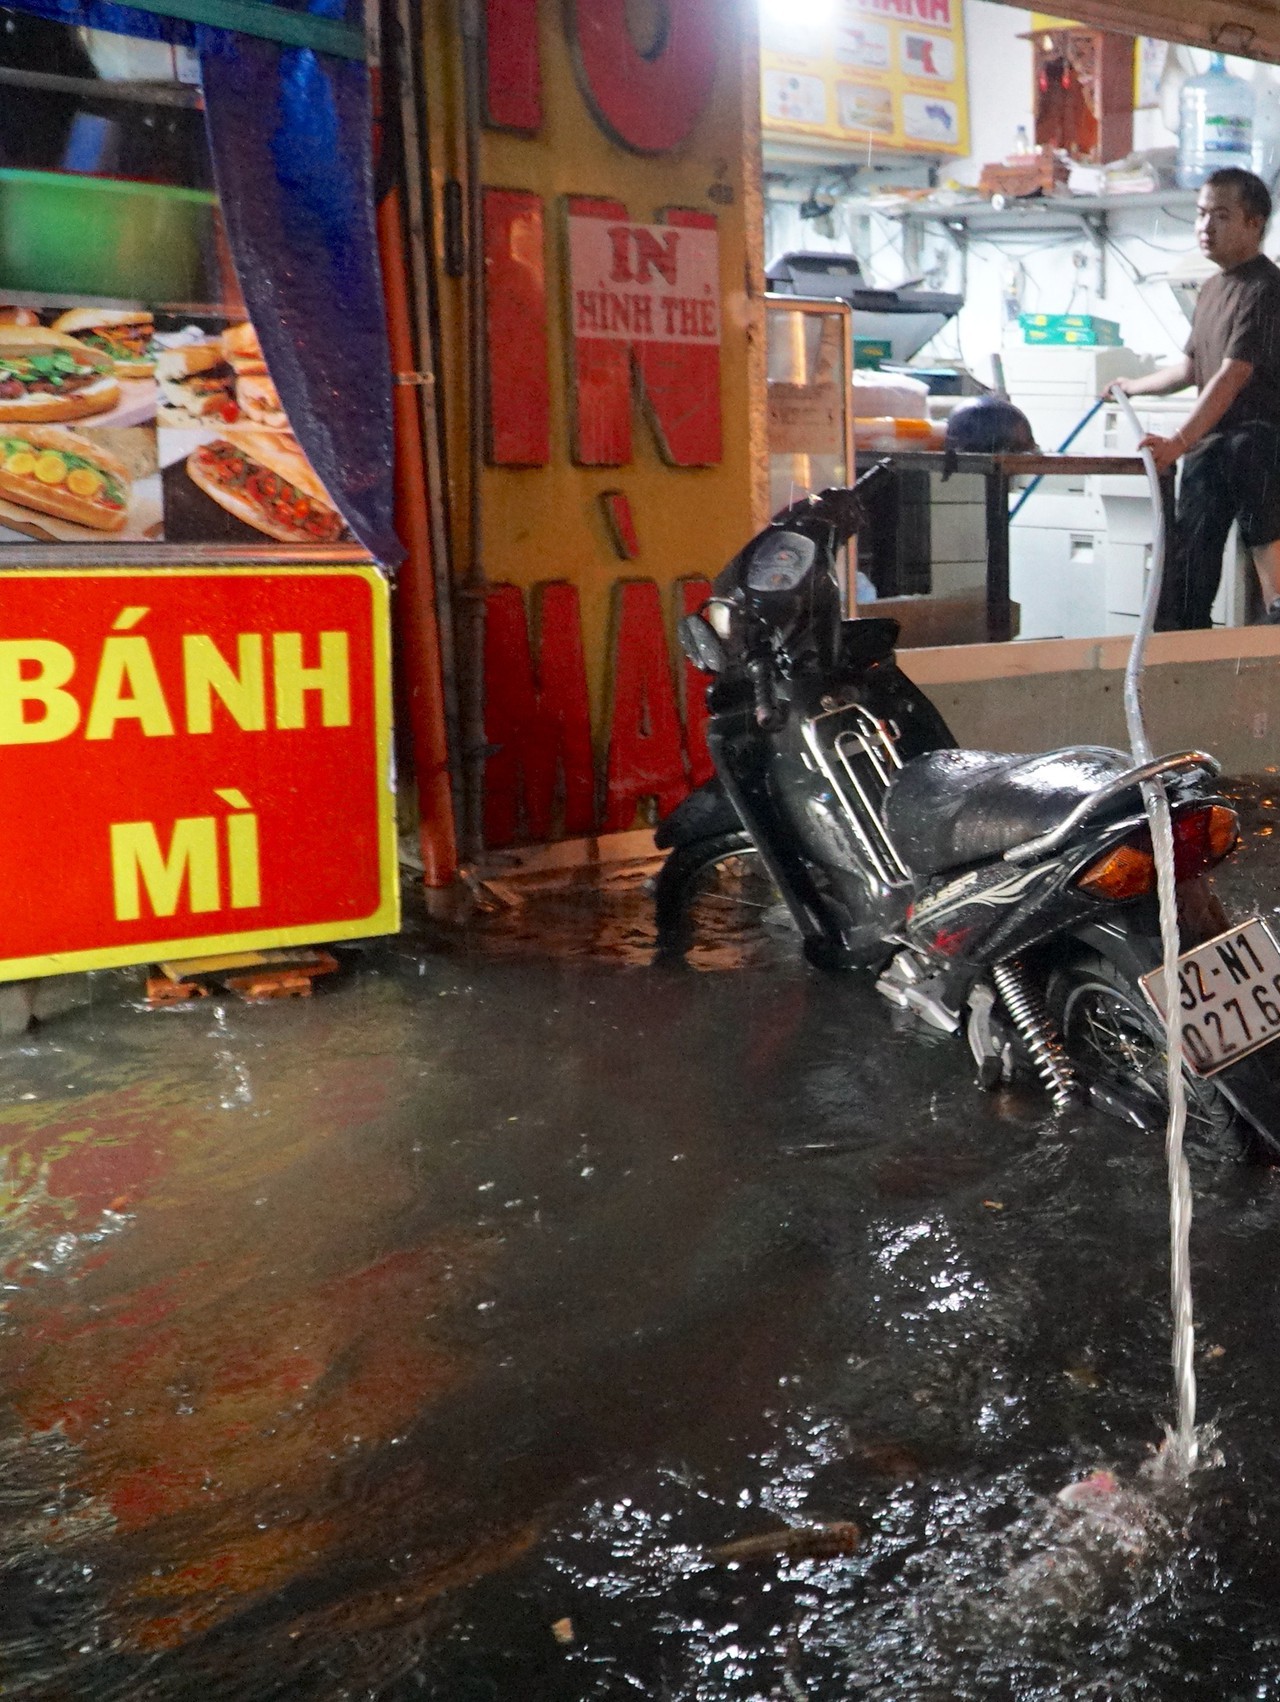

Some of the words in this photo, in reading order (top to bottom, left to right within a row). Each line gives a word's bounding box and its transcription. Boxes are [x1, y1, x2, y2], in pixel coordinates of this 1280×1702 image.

[607, 226, 681, 286] IN
[0, 607, 352, 746] BÁNH
[110, 788, 261, 922] MÌ
